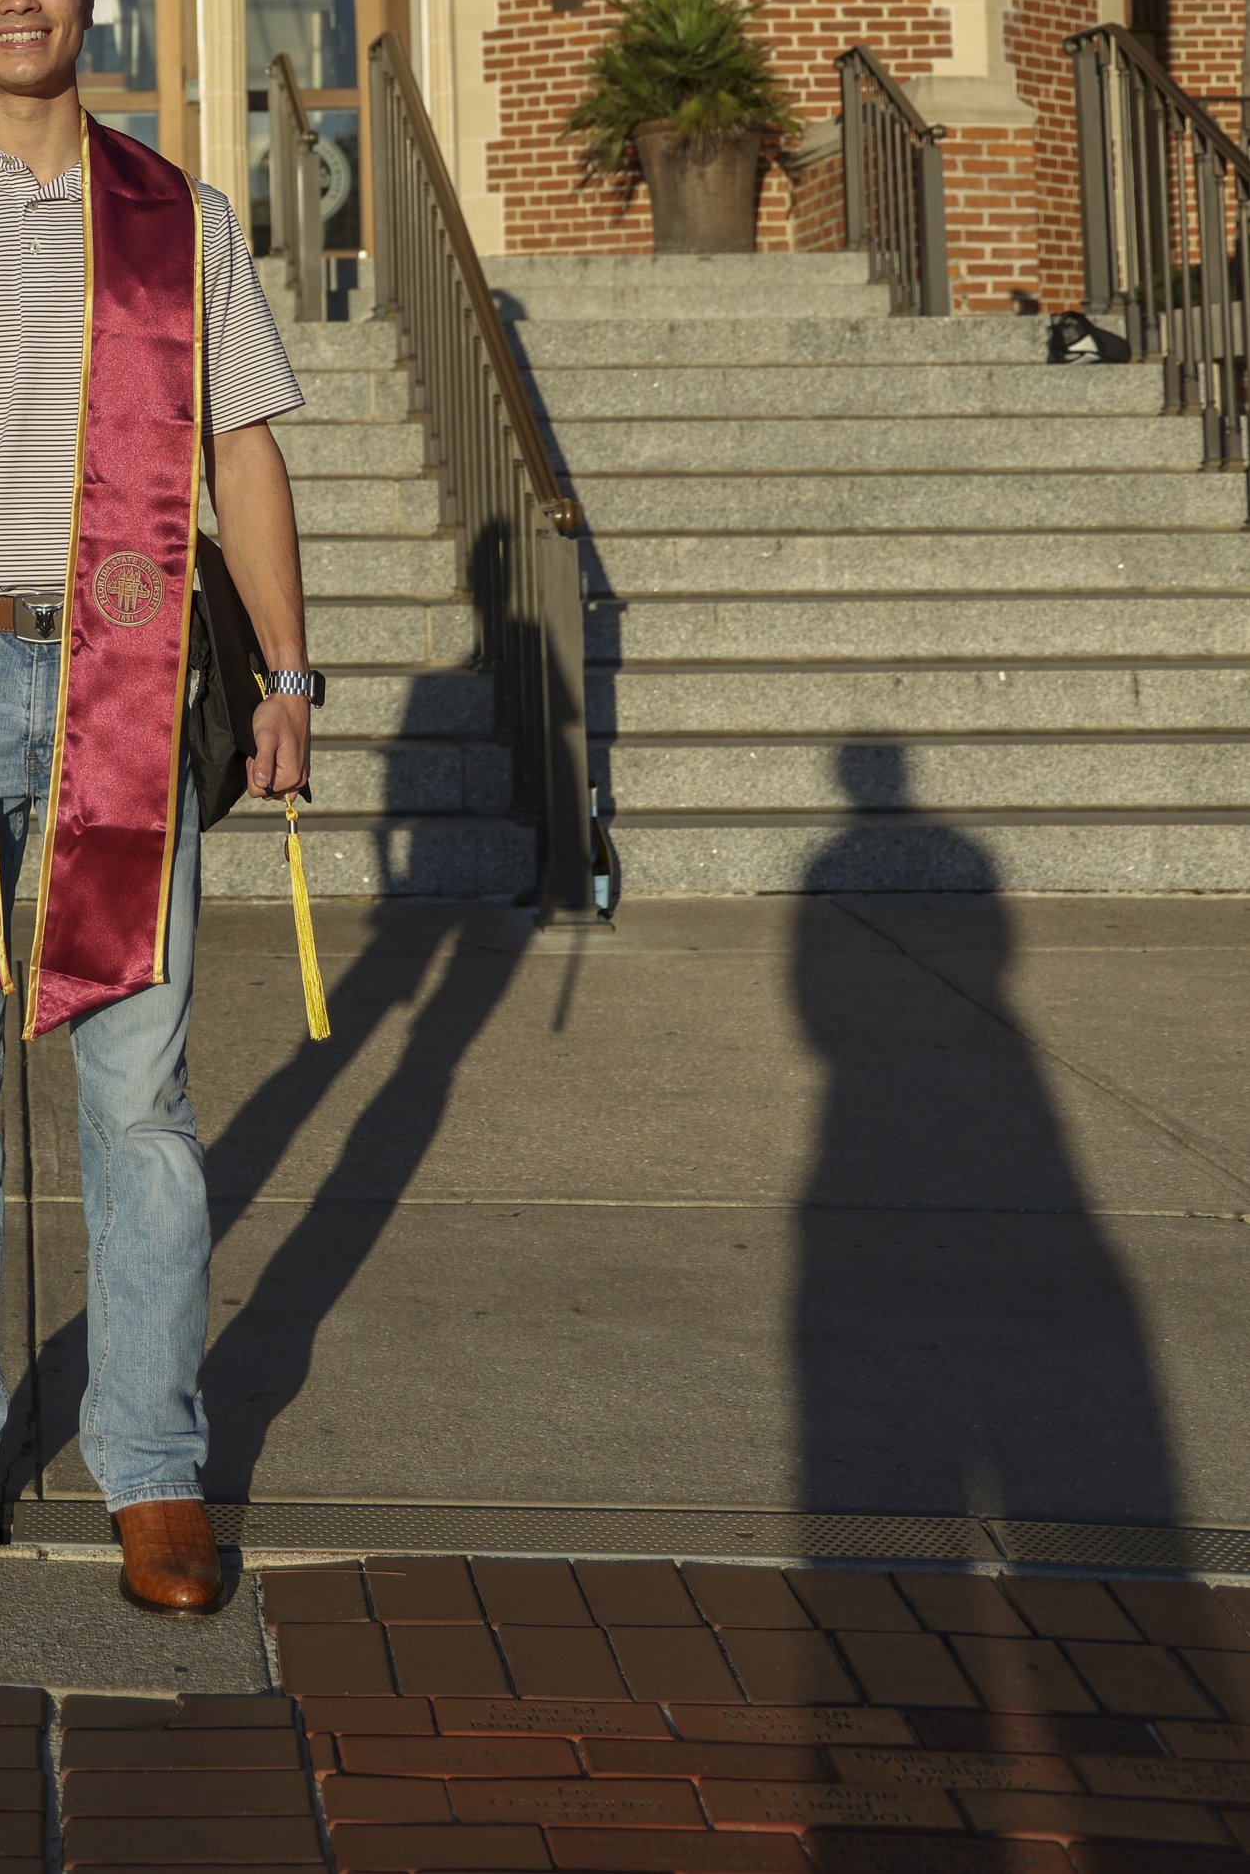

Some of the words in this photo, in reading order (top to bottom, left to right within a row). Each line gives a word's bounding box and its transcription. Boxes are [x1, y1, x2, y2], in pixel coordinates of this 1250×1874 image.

[96, 566, 111, 605] FLORIDA
[112, 555, 139, 567] STATE
[140, 559, 161, 612] UNIVERSITY
[117, 613, 135, 623] 1851
[572, 1705, 596, 1715] M
[824, 1720, 863, 1731] 96
[900, 1764, 1013, 1778] Football
[824, 1788, 900, 1801] Anne
[545, 1809, 617, 1821] 2001
[839, 1811, 914, 1824] 2001
